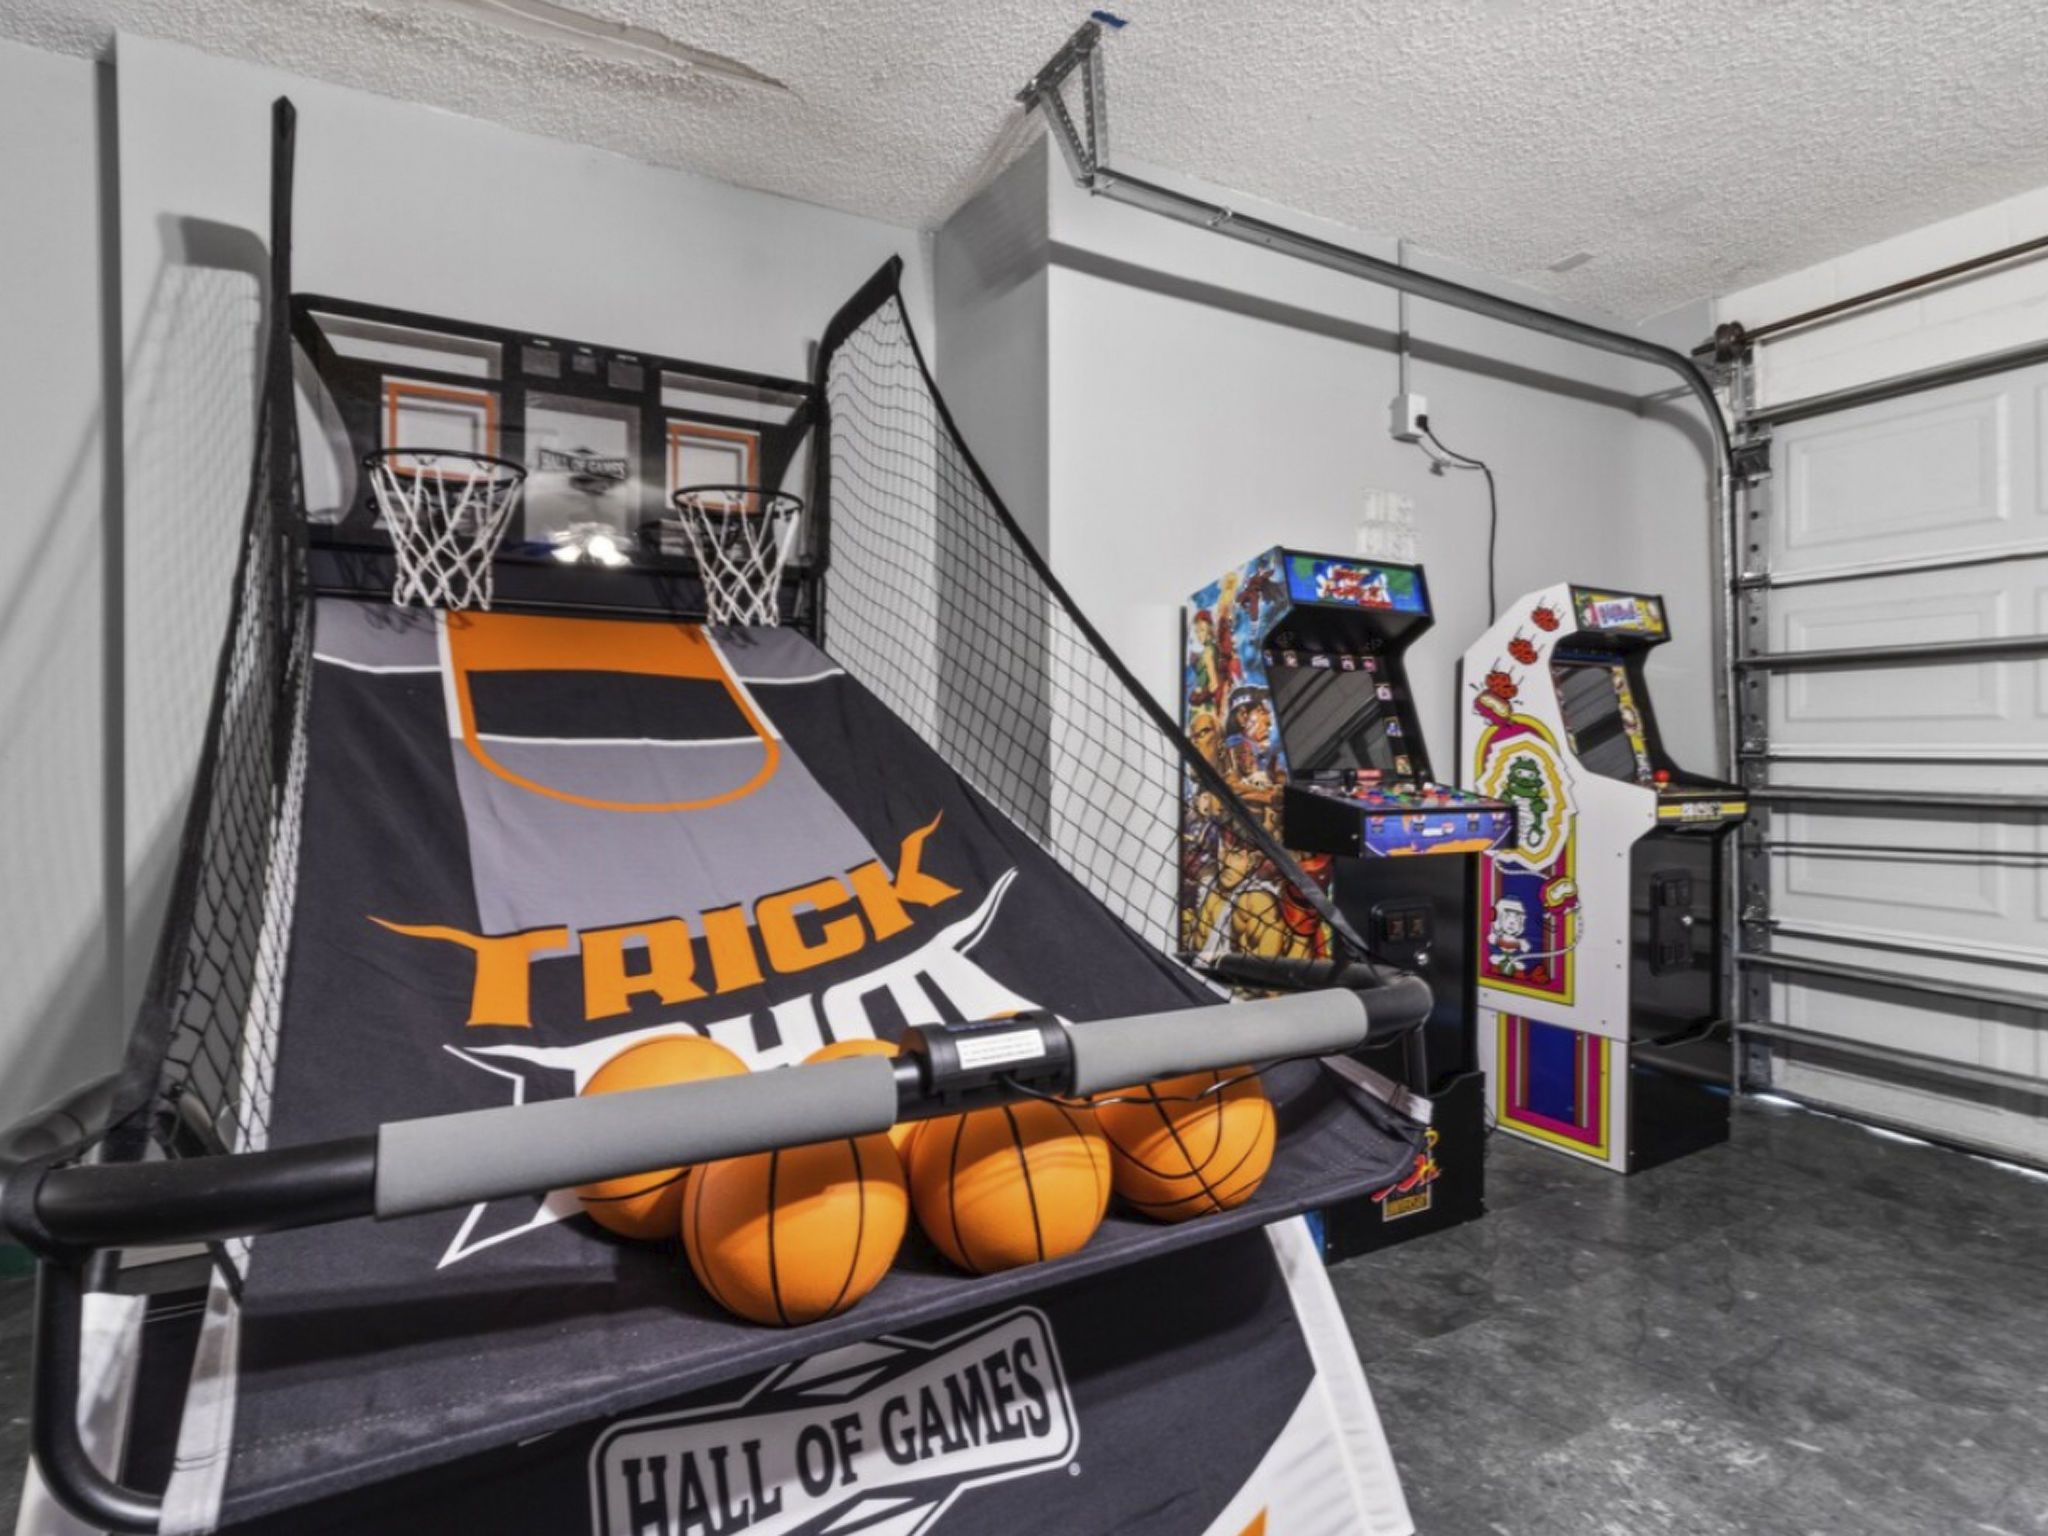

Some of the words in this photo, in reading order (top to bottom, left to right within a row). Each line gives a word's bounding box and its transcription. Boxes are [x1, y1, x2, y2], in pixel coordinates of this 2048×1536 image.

[367, 809, 963, 1028] TRICK
[622, 1439, 783, 1536] HALL
[796, 1412, 863, 1498] OF
[880, 1337, 1051, 1466] GAMES
